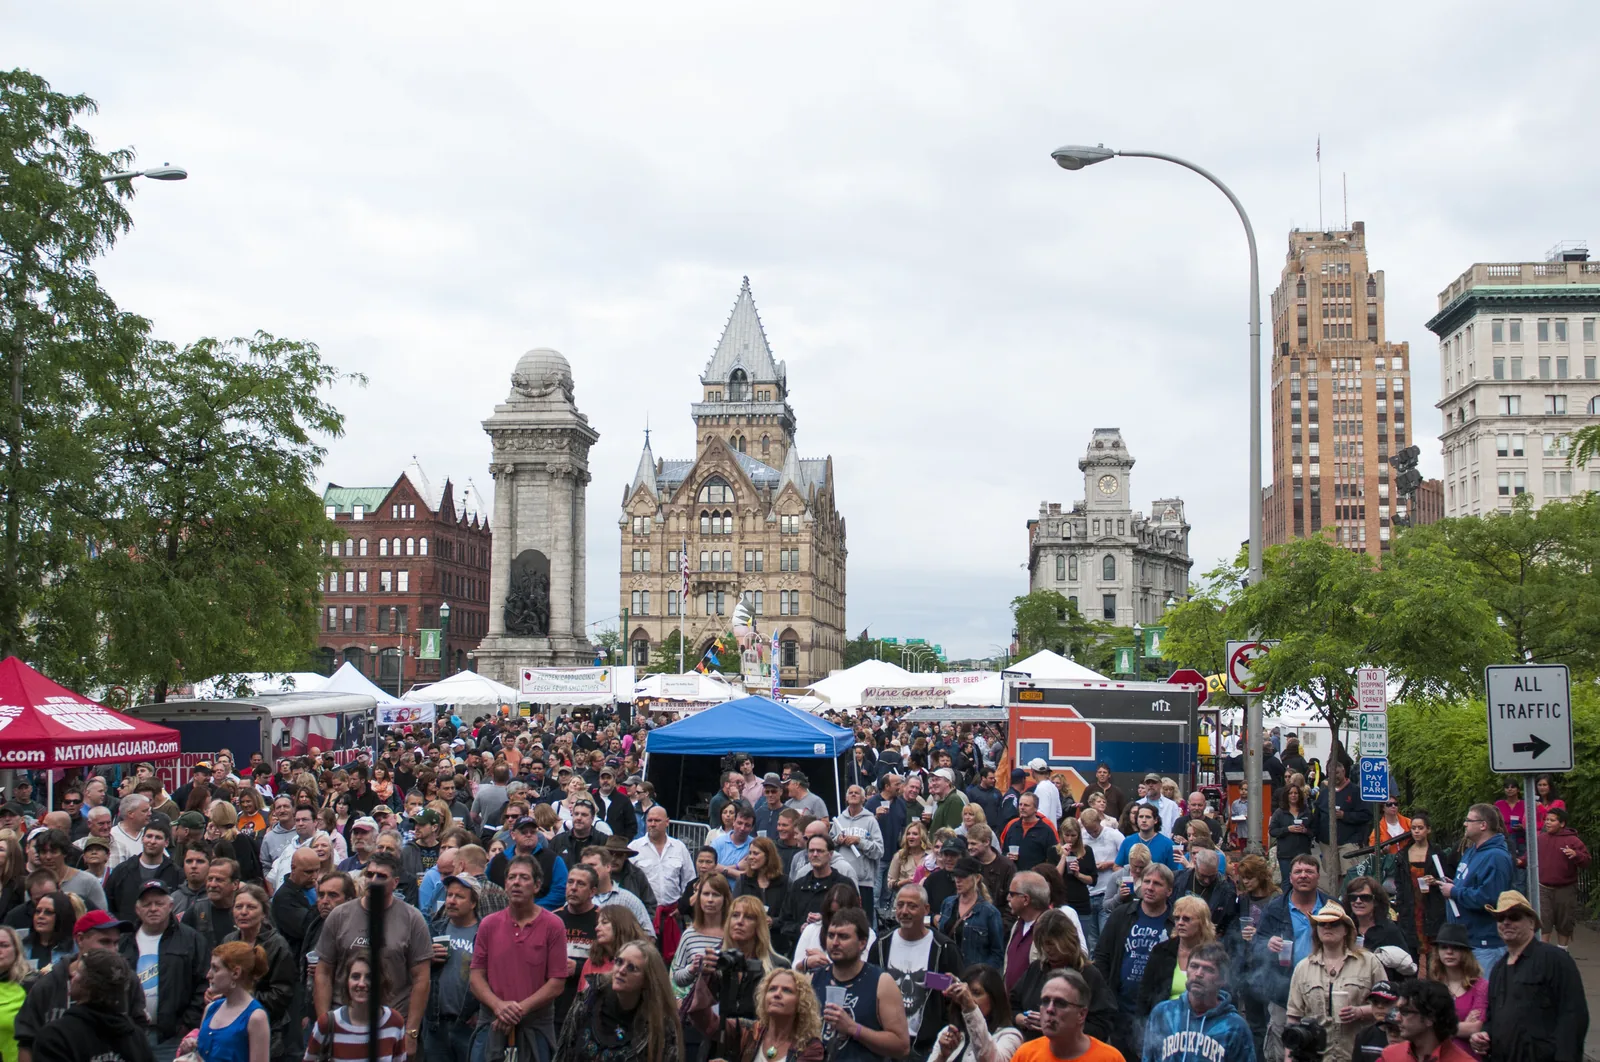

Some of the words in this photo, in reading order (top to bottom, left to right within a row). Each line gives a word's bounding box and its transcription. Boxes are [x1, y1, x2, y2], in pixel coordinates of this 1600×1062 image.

[1366, 672, 1377, 680] NO
[1514, 676, 1542, 691] ALL
[865, 688, 899, 697] Wine
[902, 687, 952, 697] Garden
[1498, 703, 1561, 719] TRAFFIC
[1361, 715, 1367, 729] 2
[0, 750, 45, 762] .com
[55, 741, 178, 762] NATIONALGUARD.com
[1131, 924, 1158, 938] Cape
[1125, 937, 1158, 952] Henry
